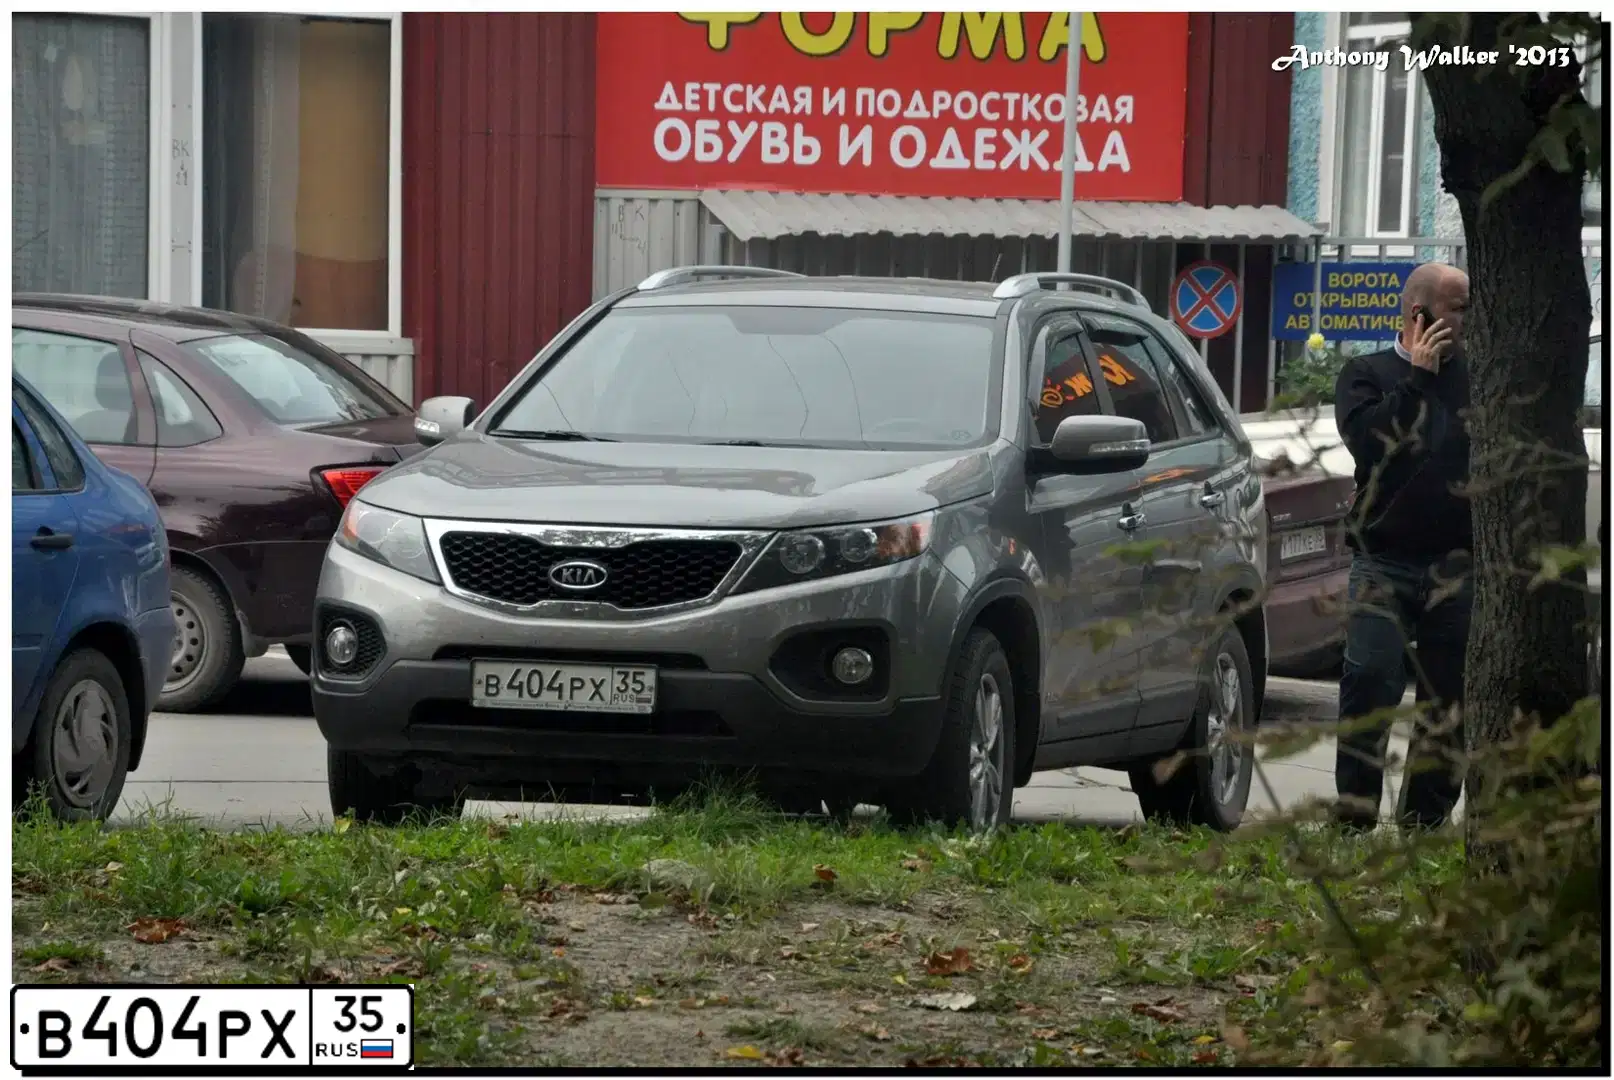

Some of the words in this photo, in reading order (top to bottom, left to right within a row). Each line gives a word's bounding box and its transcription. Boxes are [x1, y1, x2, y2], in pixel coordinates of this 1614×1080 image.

[653, 81, 813, 115] ДЕТСКАЯ
[822, 86, 846, 116] И
[855, 87, 1134, 124] ПОДРОСТКОВАЯ
[653, 117, 822, 165] ОБУВЬ
[838, 124, 873, 168] И
[889, 124, 1132, 172] ОДЕЖДА
[1328, 272, 1401, 289] ВОРОТА
[1293, 292, 1403, 308] ОТКРЫВАЮ
[1285, 314, 1405, 331] АВОМАТИЧЕ
[562, 568, 596, 583] KIA
[484, 668, 607, 702] В404РХ
[616, 671, 646, 694] 35
[613, 693, 635, 704] RUS
